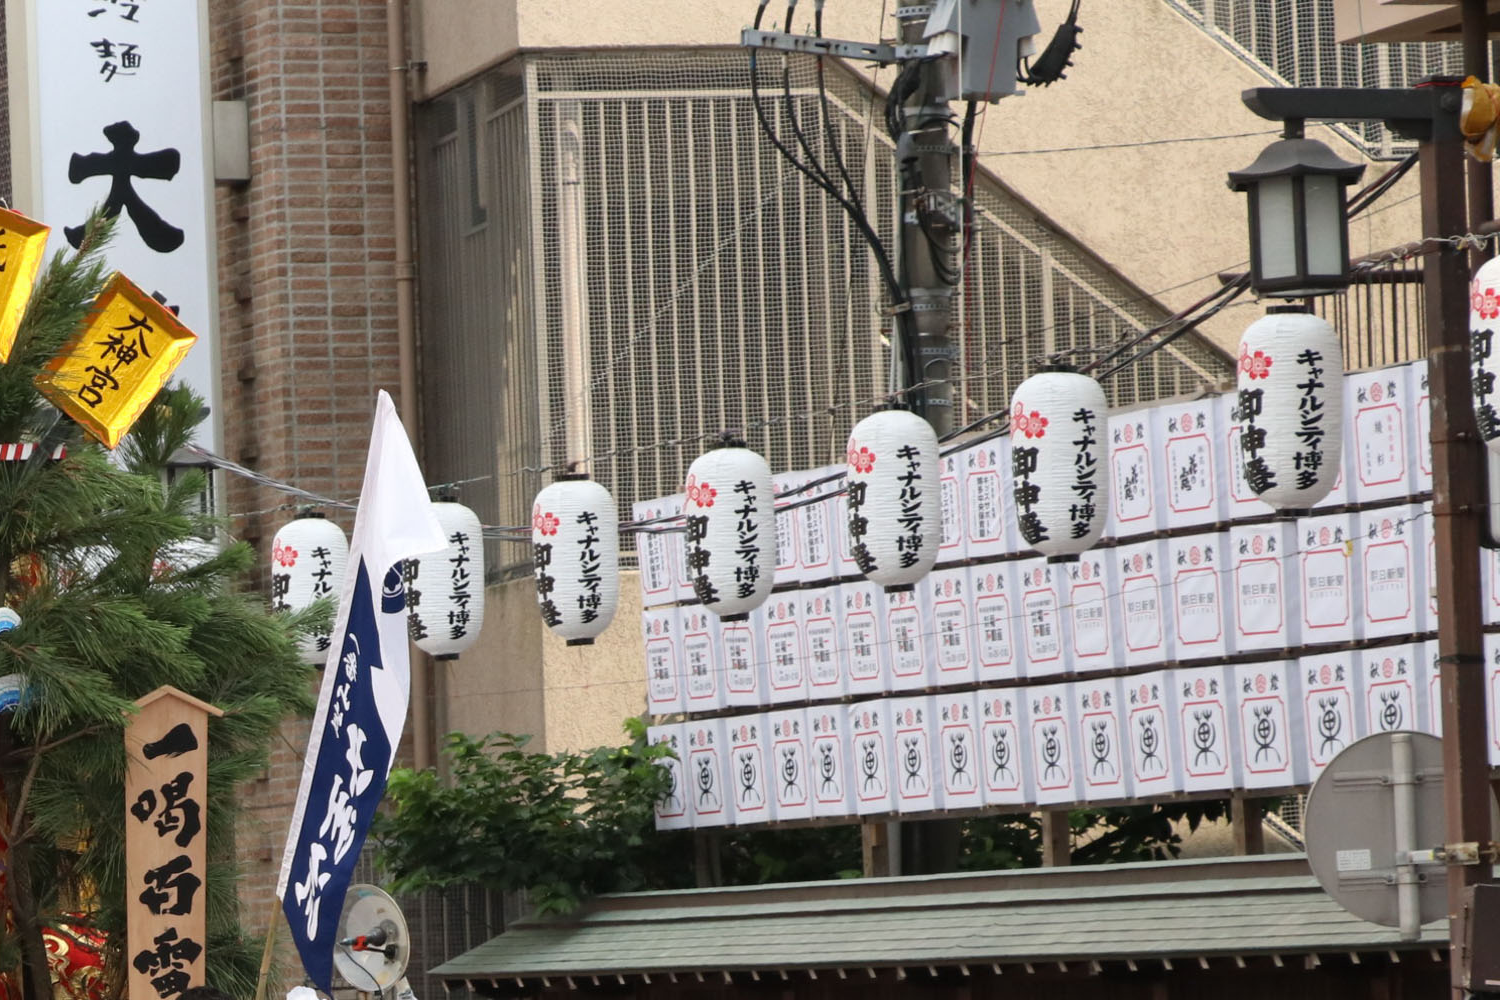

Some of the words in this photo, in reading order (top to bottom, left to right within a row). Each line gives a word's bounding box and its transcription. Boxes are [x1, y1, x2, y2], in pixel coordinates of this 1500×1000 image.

[77, 314, 154, 408] 大神宮
[1292, 349, 1325, 490] キャナルシティ博多
[896, 444, 925, 568] キャナルシティ博多
[1069, 408, 1097, 539] キャナルシティ博多
[448, 531, 471, 640] キャナルシティ博多
[577, 511, 601, 623] キャナルシティ博多
[734, 480, 760, 599] キャナルシティ博多
